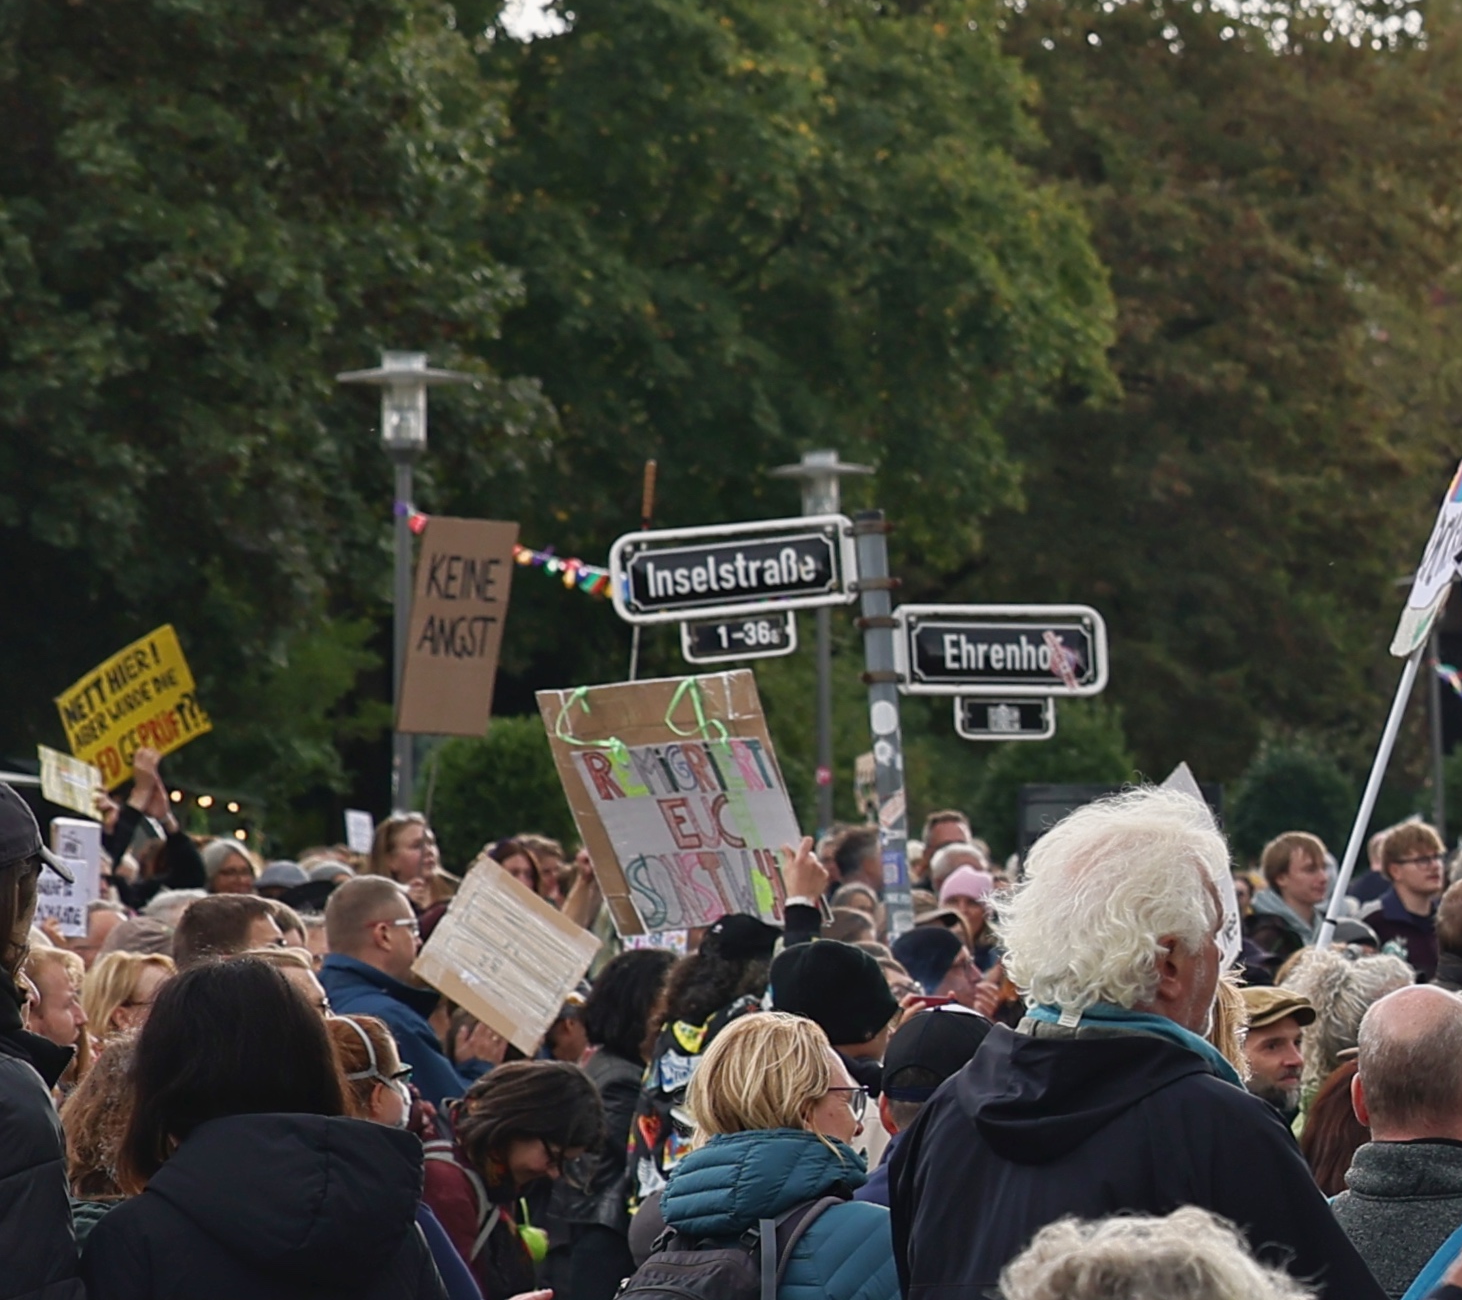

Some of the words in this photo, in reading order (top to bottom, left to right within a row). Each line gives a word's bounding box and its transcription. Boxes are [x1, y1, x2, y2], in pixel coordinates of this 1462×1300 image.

[426, 553, 501, 603] KEINE
[646, 547, 817, 599] Inselstraße
[407, 614, 497, 660] ANGST
[63, 676, 107, 731] NETT
